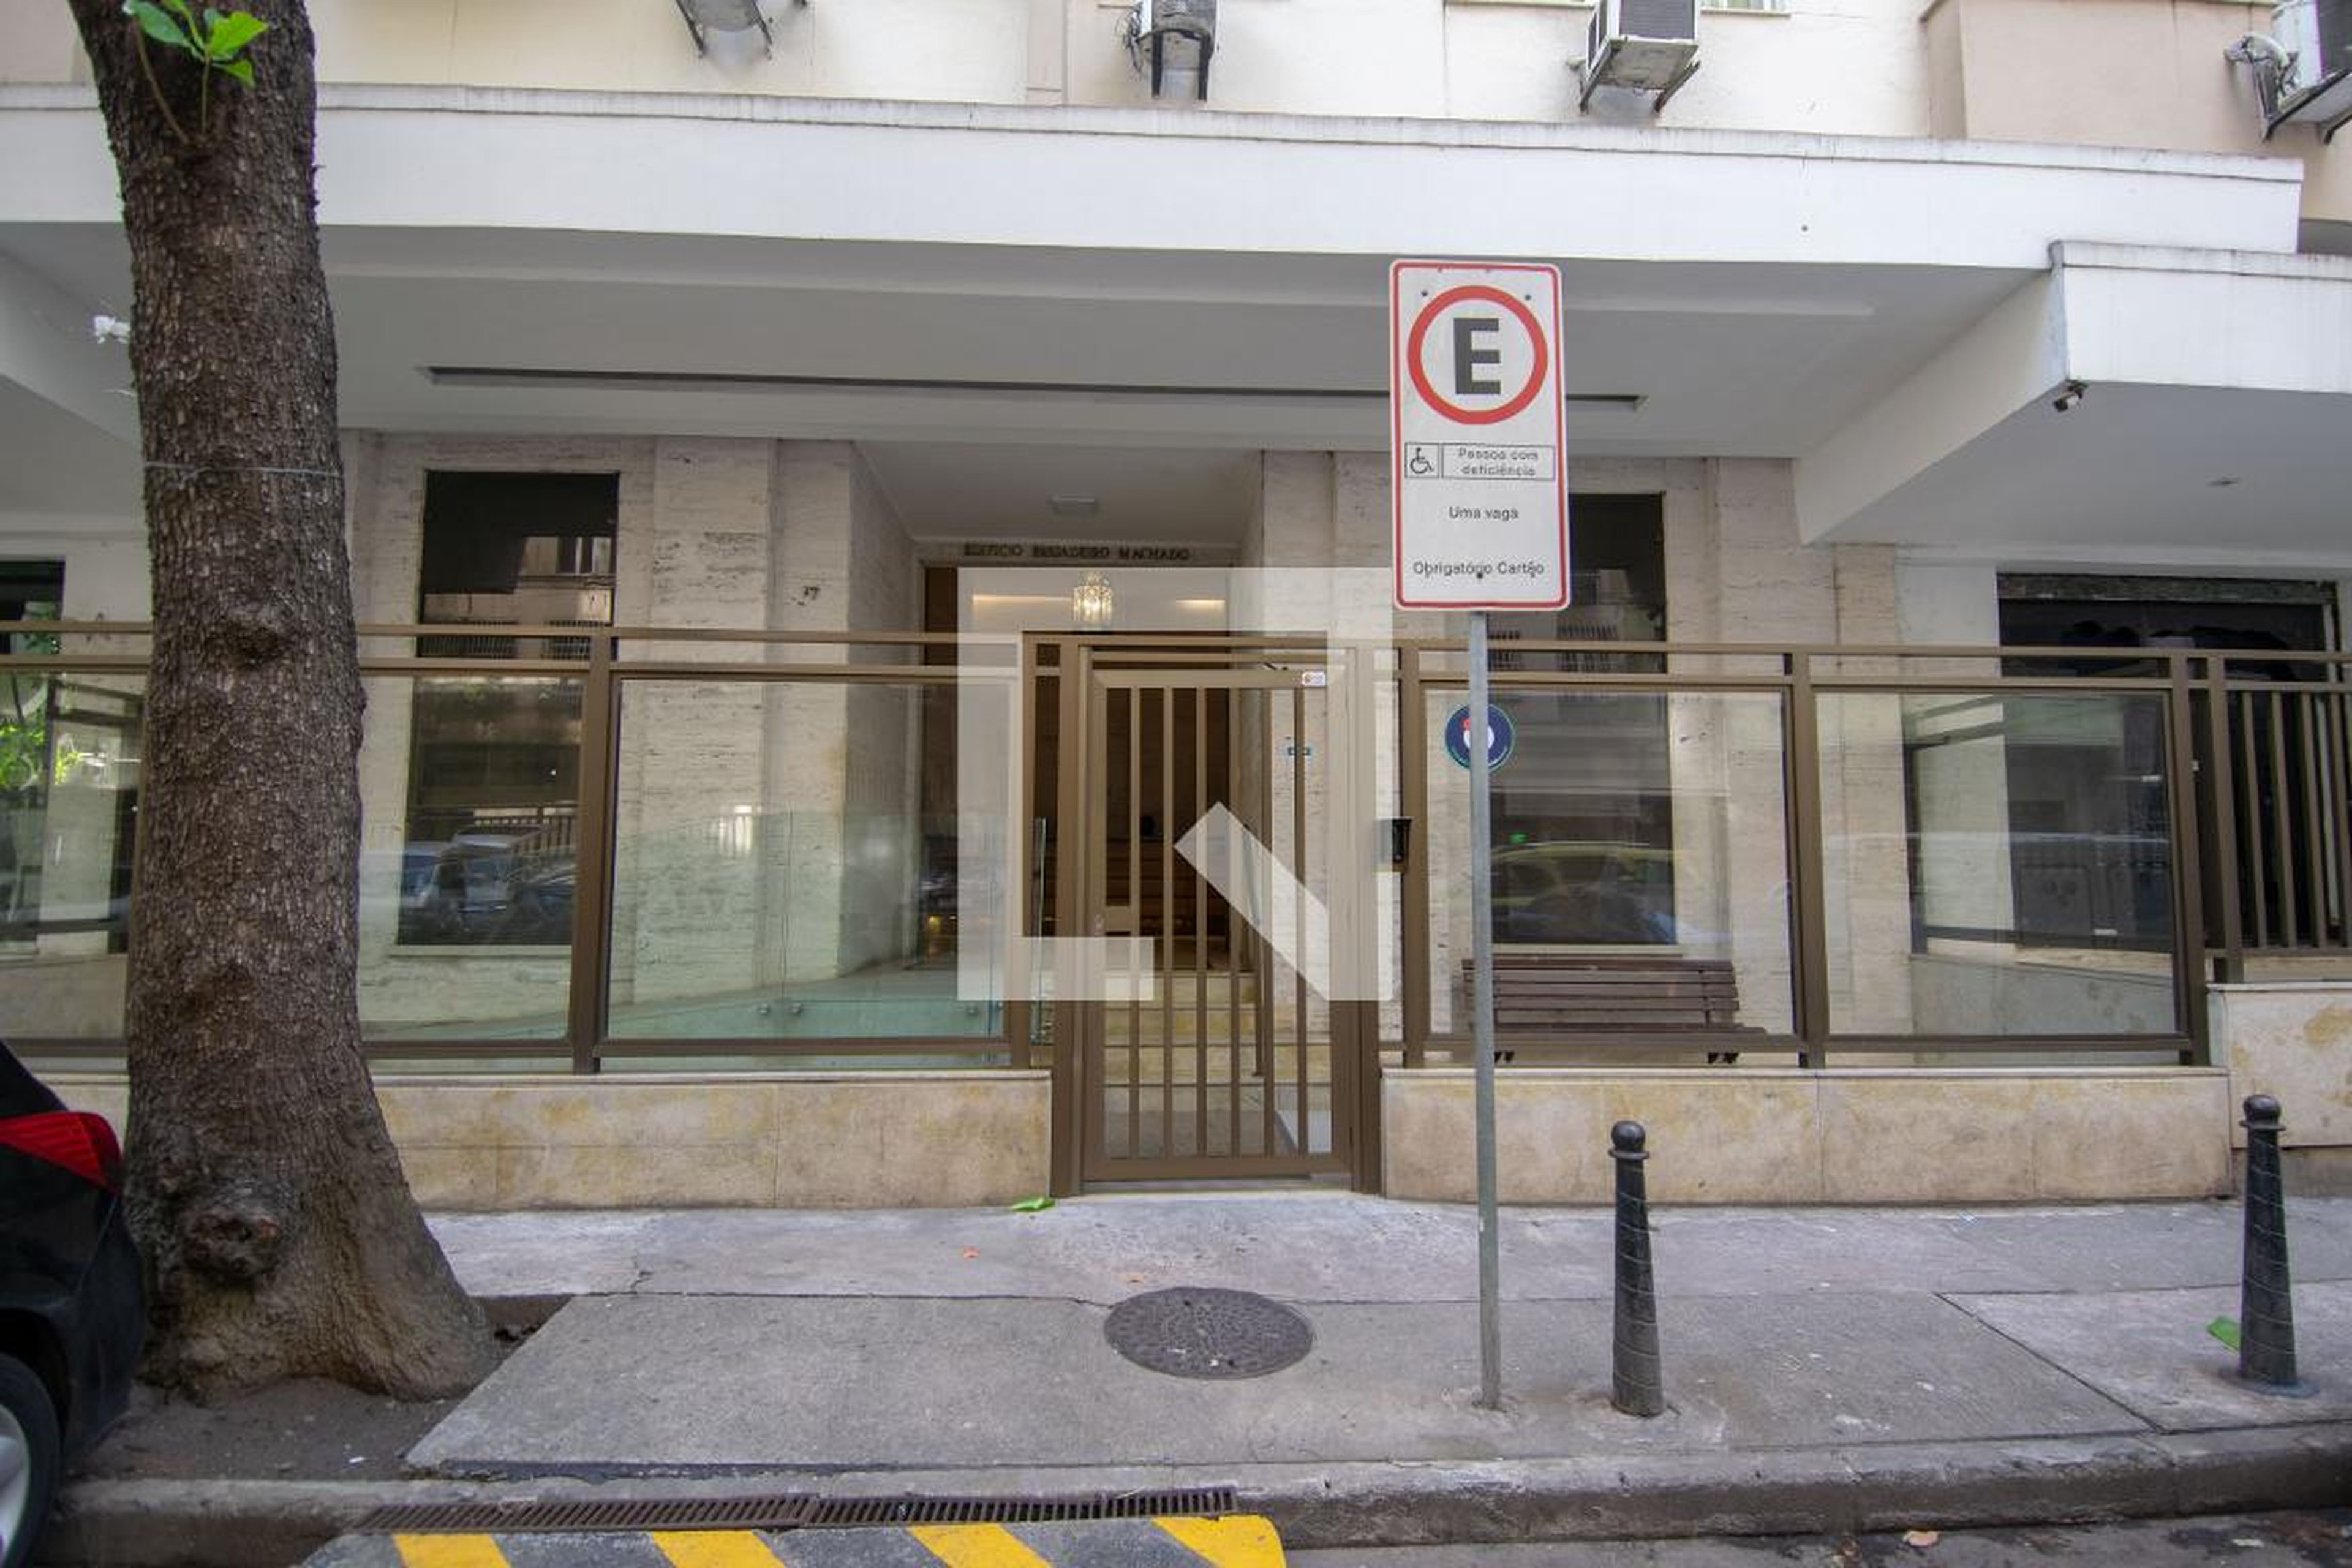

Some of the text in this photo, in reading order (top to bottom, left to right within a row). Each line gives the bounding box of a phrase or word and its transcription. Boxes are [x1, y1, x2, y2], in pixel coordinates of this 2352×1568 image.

[1453, 318, 1501, 394] E
[1459, 447, 1538, 461] Pessoa com
[1461, 464, 1536, 476] deficiência
[1449, 507, 1519, 521] Uma vaga
[1412, 561, 1493, 576] Obrigatório
